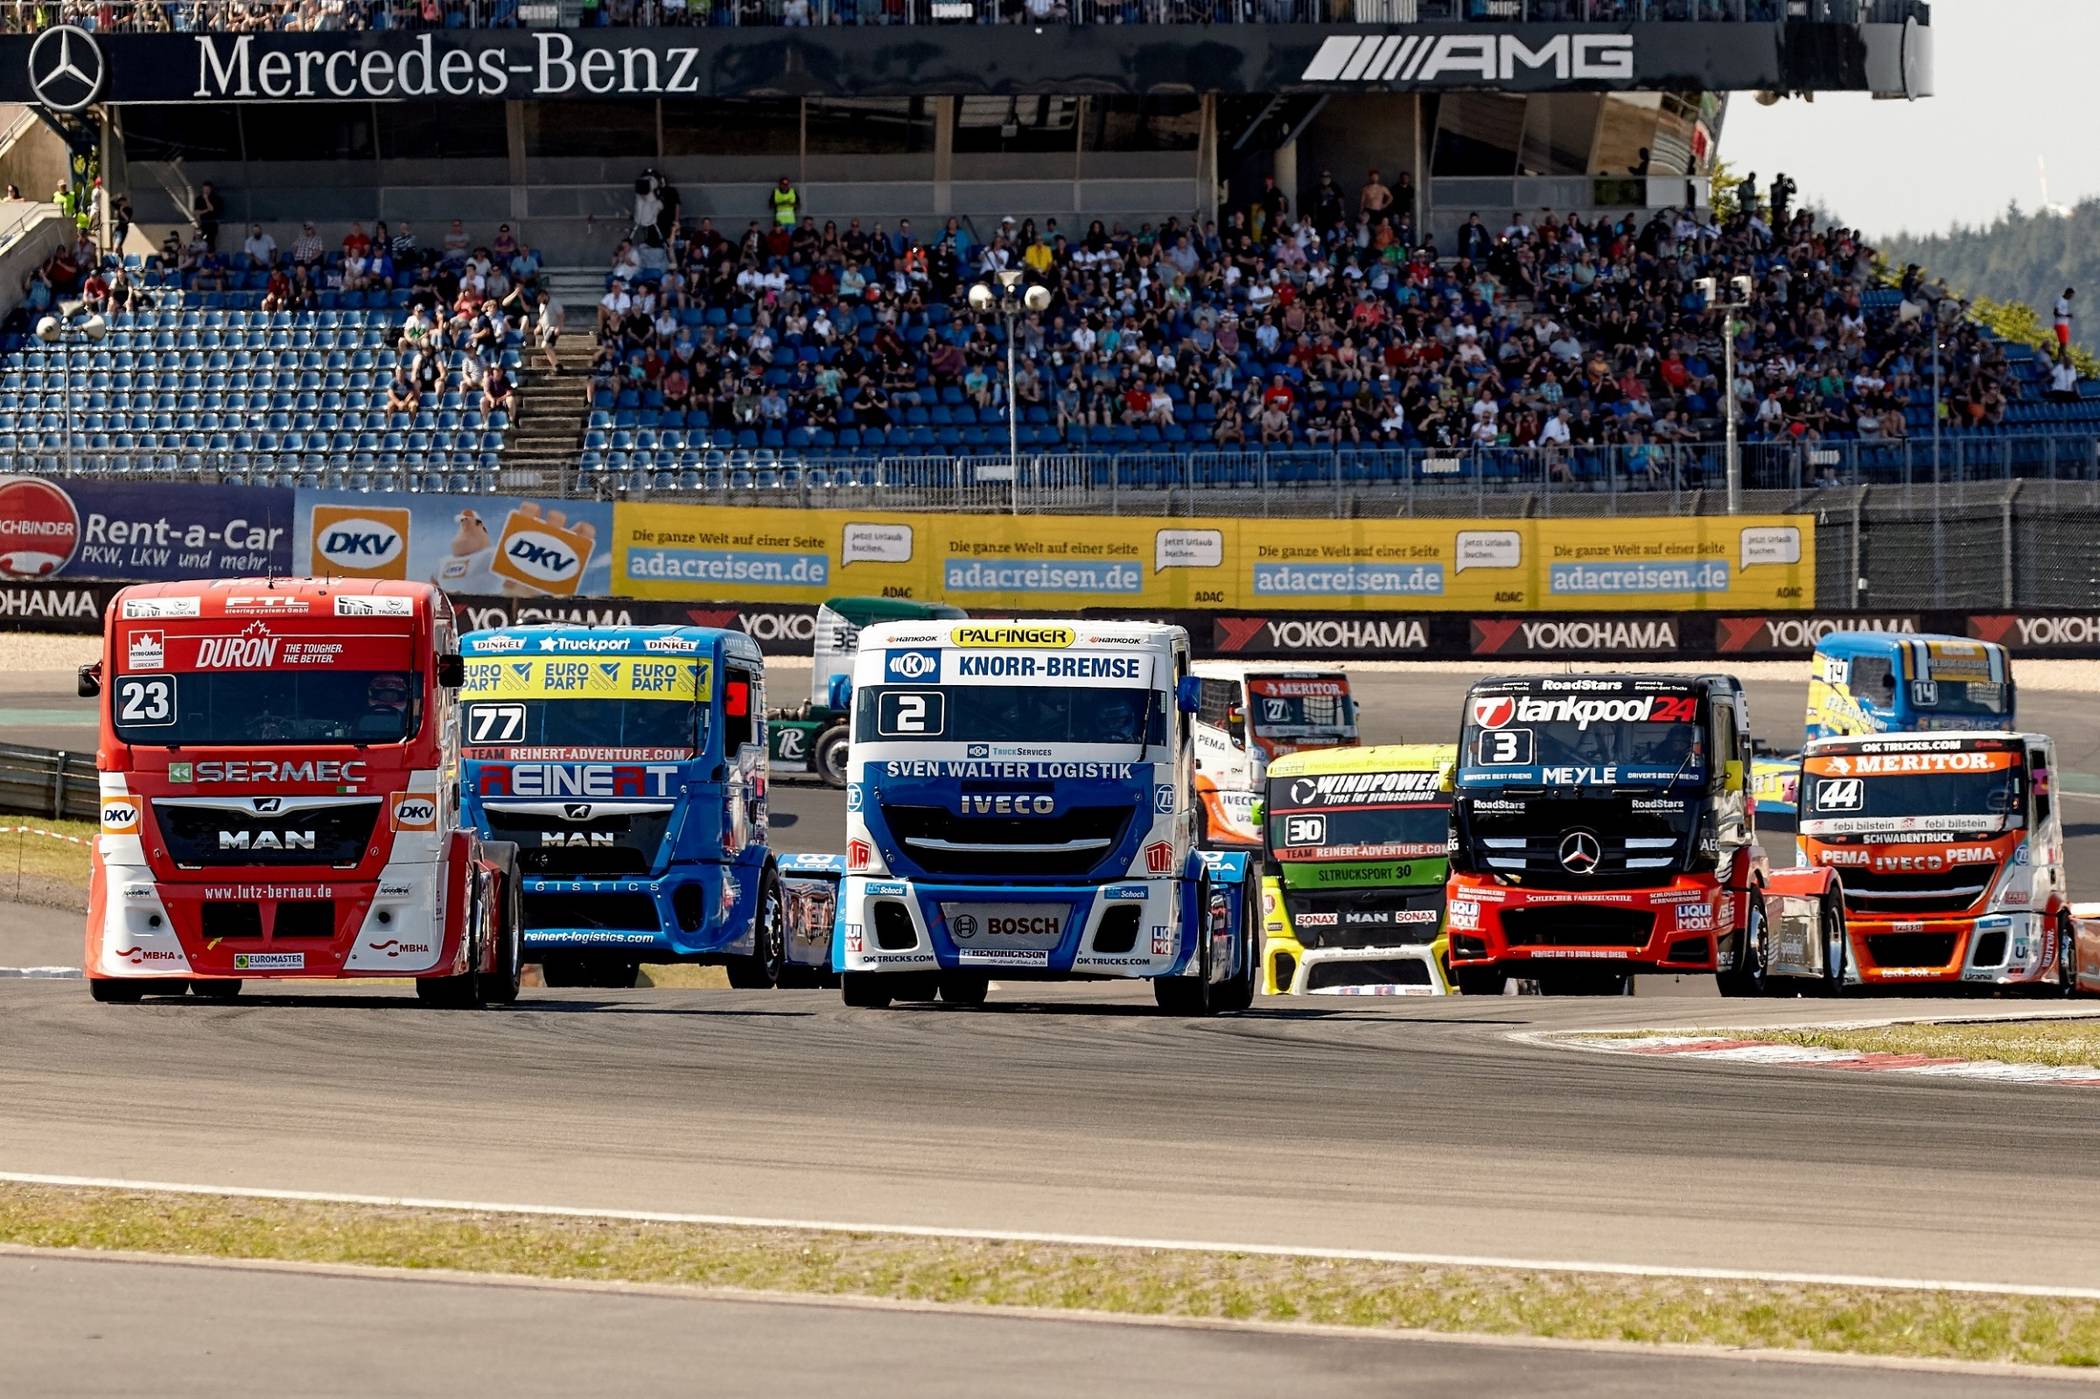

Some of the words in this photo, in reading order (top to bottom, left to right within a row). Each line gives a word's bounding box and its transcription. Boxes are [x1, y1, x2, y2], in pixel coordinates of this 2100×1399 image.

[1417, 34, 1634, 79] AMG
[193, 32, 700, 98] Mercedes-Benz
[85, 513, 284, 551] Rent-a-Car
[632, 530, 654, 542] Die
[657, 532, 696, 546] ganze
[699, 533, 728, 545] Welt
[732, 534, 754, 547] auf
[756, 535, 790, 548] einer
[793, 536, 825, 549] Seite
[326, 532, 396, 555] DKV
[950, 541, 970, 553] Die
[974, 543, 1011, 556] ganze
[1014, 542, 1044, 554] Welt
[1047, 542, 1068, 554] auf
[1071, 542, 1104, 554] einer
[1107, 543, 1139, 555] Seite
[1554, 545, 1573, 557] Die
[1575, 547, 1611, 558] ganze
[1613, 544, 1641, 556] Welt
[1643, 544, 1663, 555] auf
[1665, 544, 1694, 555] einer
[1697, 543, 1725, 554] Seite
[130, 549, 171, 567] LKW
[178, 551, 213, 569] und
[509, 538, 575, 572] DKV
[1258, 545, 1279, 557] Die
[1282, 547, 1319, 560] ganze
[1322, 546, 1350, 557] Welt
[1353, 545, 1374, 557] auf
[1376, 545, 1408, 557] einer
[1410, 545, 1440, 558] Seite
[631, 552, 825, 584] adacreisen.de
[949, 563, 1139, 589] adacreisen.de
[1258, 567, 1440, 592] adacreisen.de
[1554, 565, 1726, 590] adacreisen.de
[882, 586, 913, 599] ADAC
[1195, 591, 1224, 602] ADAC
[225, 597, 309, 608] FTL
[959, 629, 1067, 643] PALFINGER
[1268, 621, 1428, 648] YOKOHAMA
[1522, 622, 1676, 649] YOKOHAMA
[285, 644, 302, 653] THE
[304, 644, 343, 653] TOUGHER.
[477, 641, 520, 649] DINKEL
[558, 637, 631, 652] Truckport
[649, 641, 694, 650] DINKEL
[196, 637, 279, 668] DURON
[283, 655, 298, 663] THE
[300, 655, 334, 663] BETTER.
[545, 663, 590, 676] EURO
[632, 664, 677, 678] EURO
[959, 656, 1140, 679] KNORR-BREMSE
[1830, 664, 1844, 682] 14
[544, 676, 589, 690] PART
[631, 677, 676, 692] PART
[1542, 680, 1623, 691] RoadStars
[1915, 682, 1935, 702] 14
[121, 681, 169, 720] 23
[897, 696, 926, 731] 2
[1268, 701, 1284, 720] 27
[1516, 695, 1698, 731] tankpool24
[473, 707, 522, 740] 77
[1197, 734, 1226, 751] PEMA
[1493, 732, 1518, 762] 3
[1862, 743, 1881, 752] OK
[1883, 740, 1961, 752] TRUCKS.COM
[470, 748, 505, 760] TEAM
[510, 748, 685, 761] REINERT-ADVENTURE.COM
[887, 760, 939, 777] SVEN
[947, 762, 1030, 778] WALTER
[1037, 763, 1132, 779] LOGISTIK
[1855, 753, 1996, 773] MERITOR.
[196, 760, 366, 783] SERMEC
[1542, 767, 1618, 784] MEYLE
[480, 764, 678, 797] REINERT
[1323, 793, 1350, 804] Tyres
[1351, 793, 1366, 803] for
[1367, 790, 1436, 804] professionals
[1820, 780, 1860, 808] 44
[961, 795, 1055, 814] IVECO
[1473, 799, 1526, 809] RoadStars
[1631, 799, 1685, 809] RoadStars
[104, 810, 136, 822] DKV
[398, 805, 433, 819] DKV
[1290, 819, 1322, 841] 30
[1833, 821, 1854, 831] febi
[1856, 820, 1895, 831] bilstein
[1925, 819, 1945, 829] febi
[1948, 818, 1987, 828] bilstein
[218, 831, 315, 850] MAN
[541, 832, 614, 847] MAN
[1862, 833, 1955, 844] SCHWABENTRUCK
[1285, 849, 1313, 859] TEAM
[1821, 850, 1871, 864] PEMA
[1945, 847, 1996, 863] PEMA
[1876, 855, 1942, 870] IVECO
[1396, 865, 1412, 880] 30
[205, 883, 332, 899] www.lutz-bernau.de
[1120, 889, 1145, 898] Schoch
[1345, 912, 1389, 923] MAN
[1397, 911, 1436, 921] SONAX
[1678, 905, 1712, 917] LIQUI
[988, 917, 1059, 935] BOSCH
[1296, 915, 1337, 925] SONAX
[1678, 918, 1713, 929] MOLY
[524, 931, 654, 945] reinert-logistics.com
[143, 951, 176, 960] MBHA
[399, 944, 429, 953] MBHA
[972, 950, 1047, 959] HENDRICKSON
[250, 954, 303, 964] EUROMASTER
[863, 955, 877, 963] OK
[878, 955, 934, 963] TRUCKS.COM
[1076, 957, 1091, 965] OK
[1093, 957, 1151, 966] TRUCKS.COM
[1964, 972, 1993, 981] Urania
